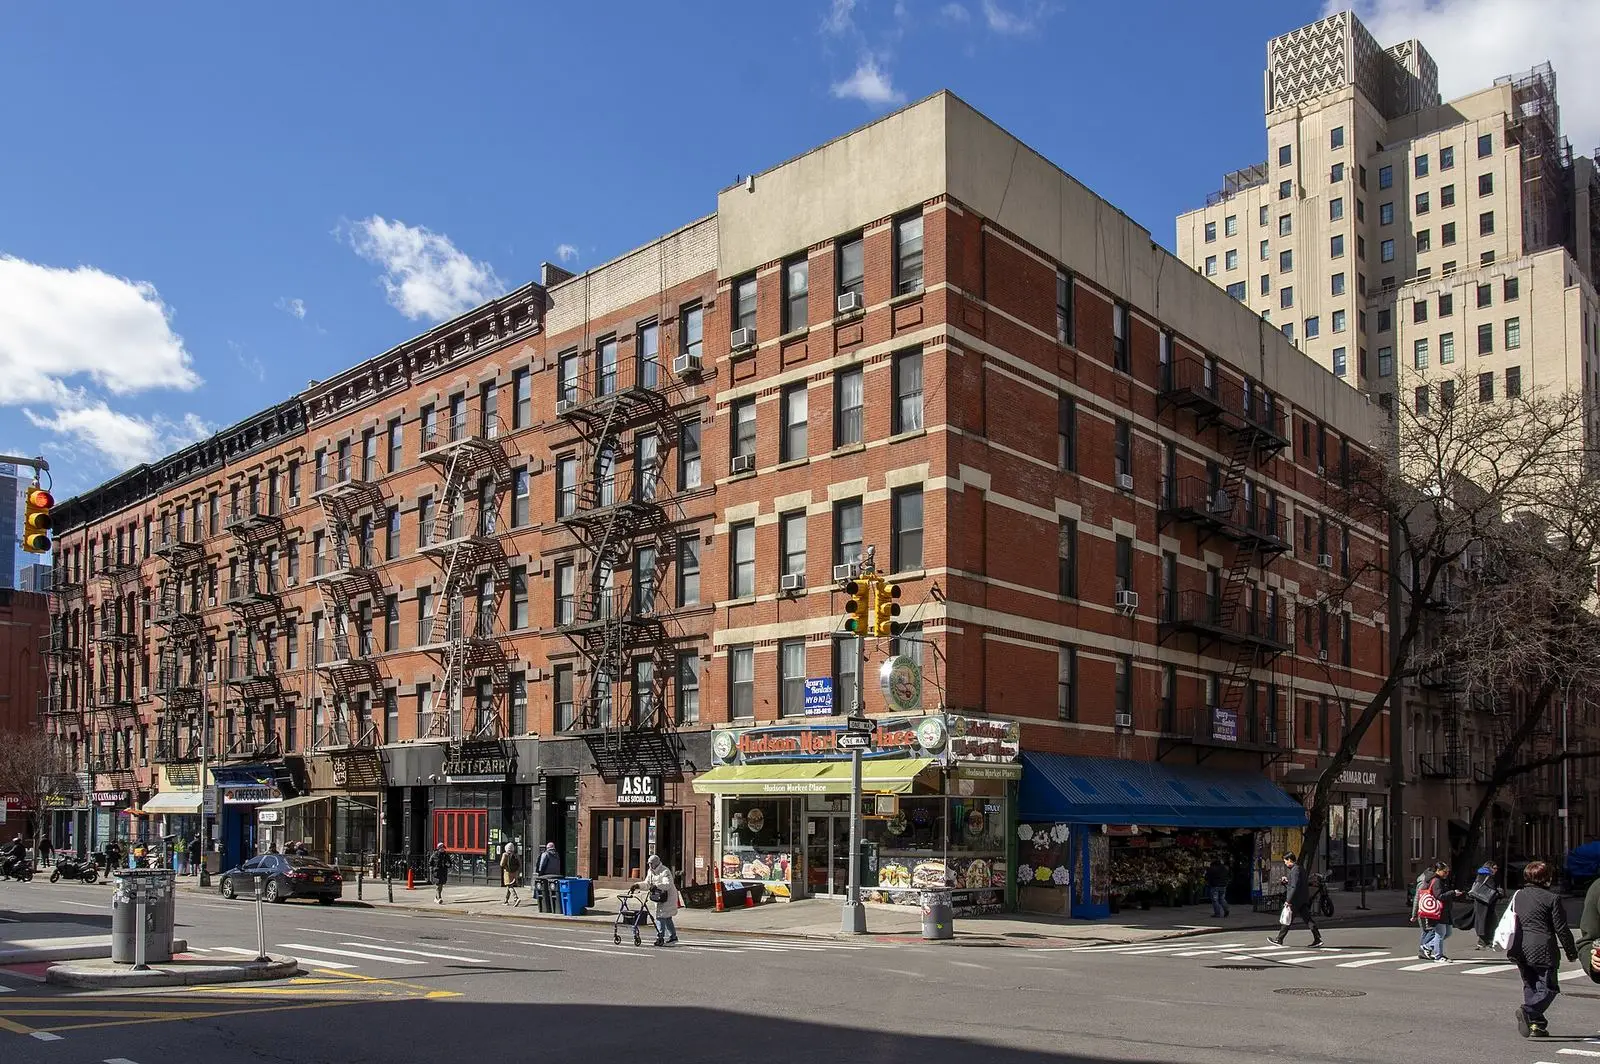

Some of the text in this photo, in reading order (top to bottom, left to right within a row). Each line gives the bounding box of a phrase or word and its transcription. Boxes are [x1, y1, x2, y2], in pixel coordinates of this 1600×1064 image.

[805, 696, 813, 704] NY
[851, 721, 860, 729] ONE
[736, 733, 796, 753] Hudson
[441, 760, 473, 775] CRAFT
[479, 758, 512, 774] CARRY
[965, 767, 985, 777] Hudson
[984, 769, 1001, 779] Market
[1362, 772, 1377, 785] CLAY
[622, 776, 654, 795] A.S.C.
[763, 783, 827, 793] Hudson Market Place
[617, 795, 657, 803] ATLAS SOCIAL CLUB
